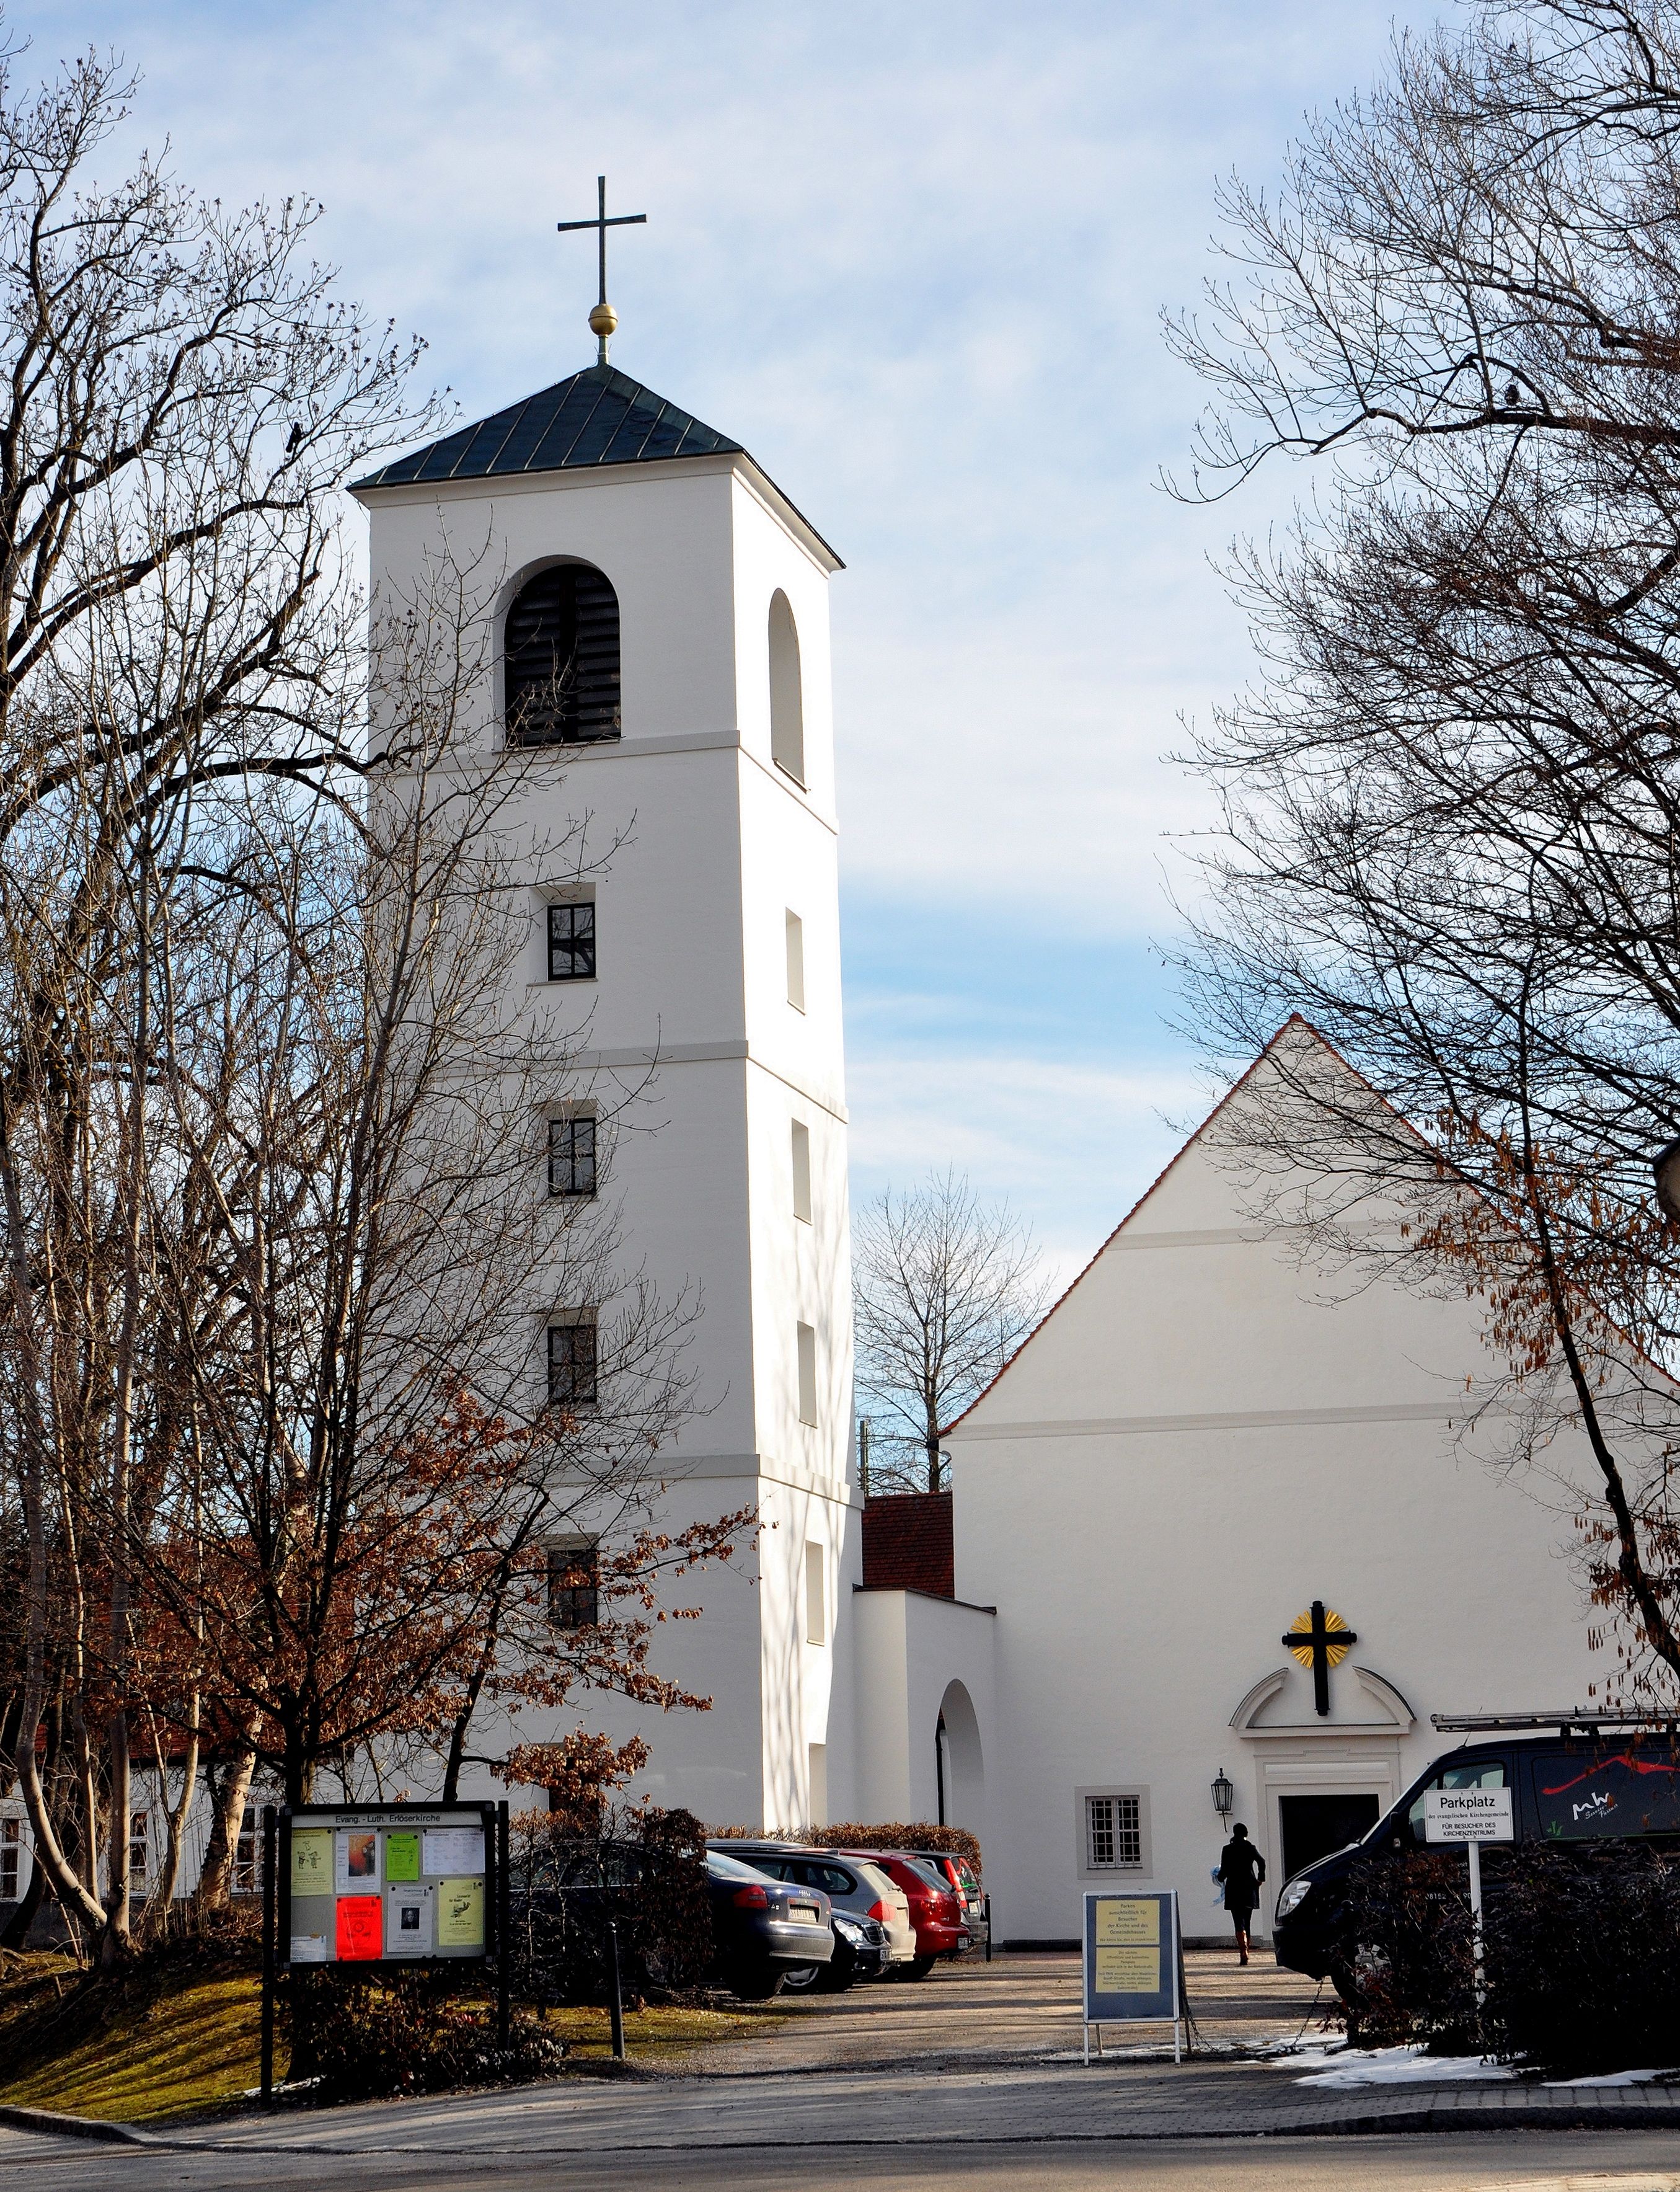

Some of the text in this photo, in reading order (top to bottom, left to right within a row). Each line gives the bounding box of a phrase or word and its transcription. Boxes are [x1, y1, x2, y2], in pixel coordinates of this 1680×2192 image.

[1440, 1796, 1495, 1809] Parkplatz
[335, 1815, 360, 1824] Evang.
[389, 1814, 441, 1822] Erlöserkirche
